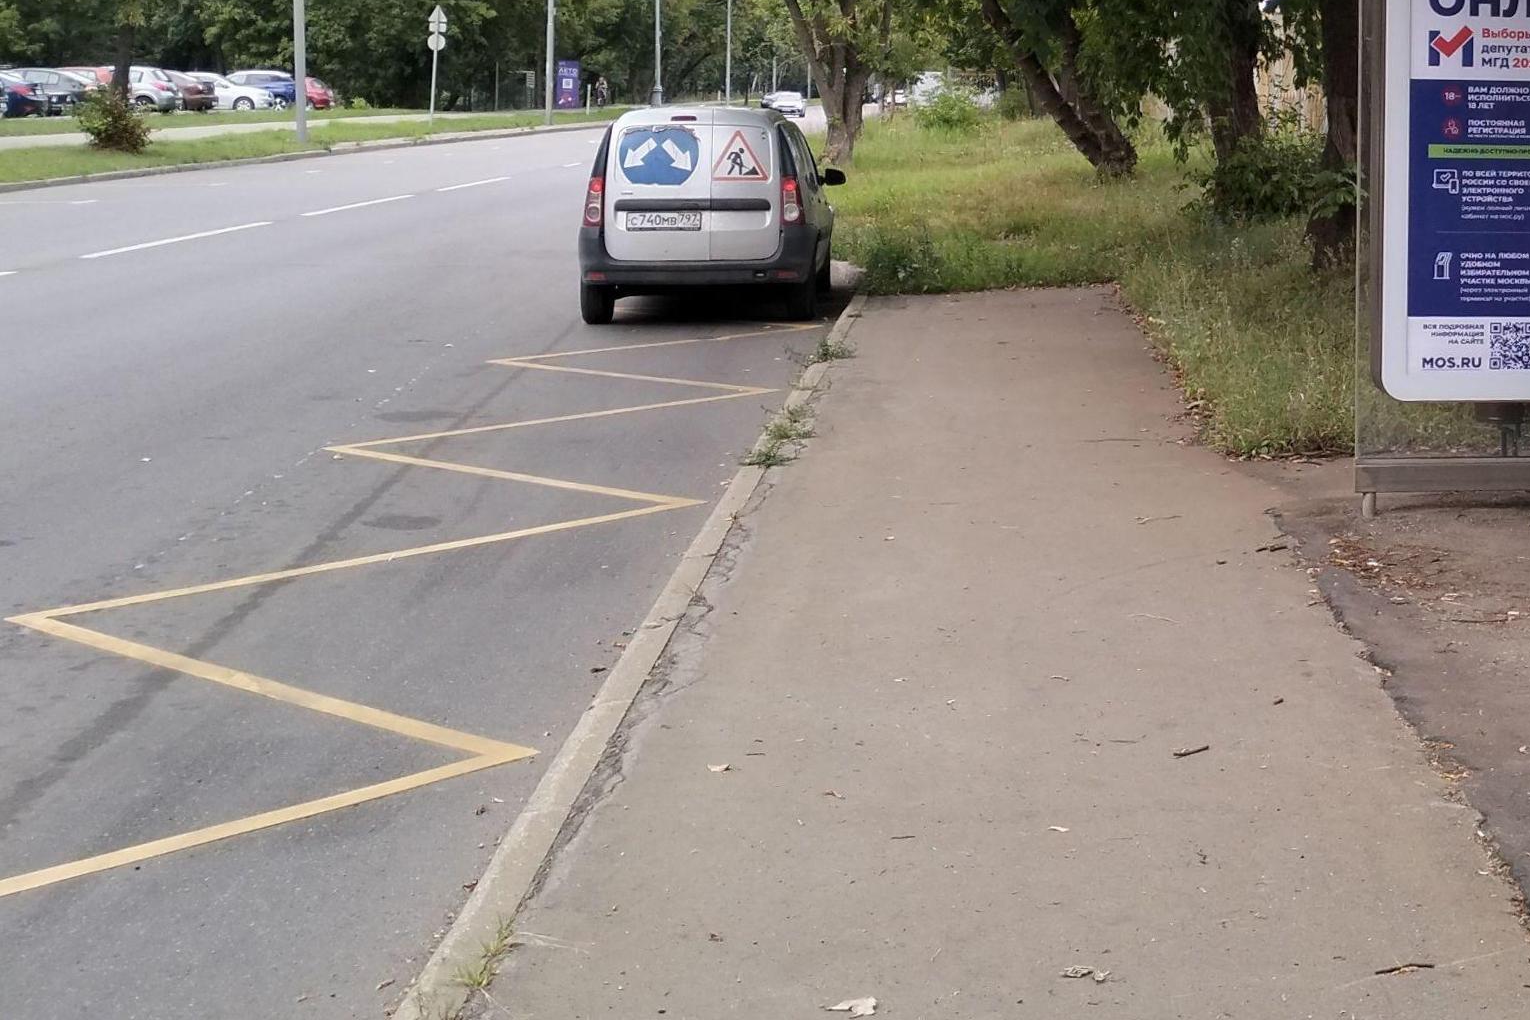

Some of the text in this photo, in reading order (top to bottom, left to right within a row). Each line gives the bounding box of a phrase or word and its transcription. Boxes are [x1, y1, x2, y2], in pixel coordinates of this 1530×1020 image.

[1481, 57, 1510, 69] МГД
[1489, 87, 1530, 95] ДОЛЖНО
[1468, 127, 1527, 135] РЕГИСТРАЦИЯ
[1475, 170, 1497, 178] ВСЕЙ
[1461, 195, 1513, 203] УСТРОЙСТВА
[1422, 357, 1482, 369] MOS.RU
